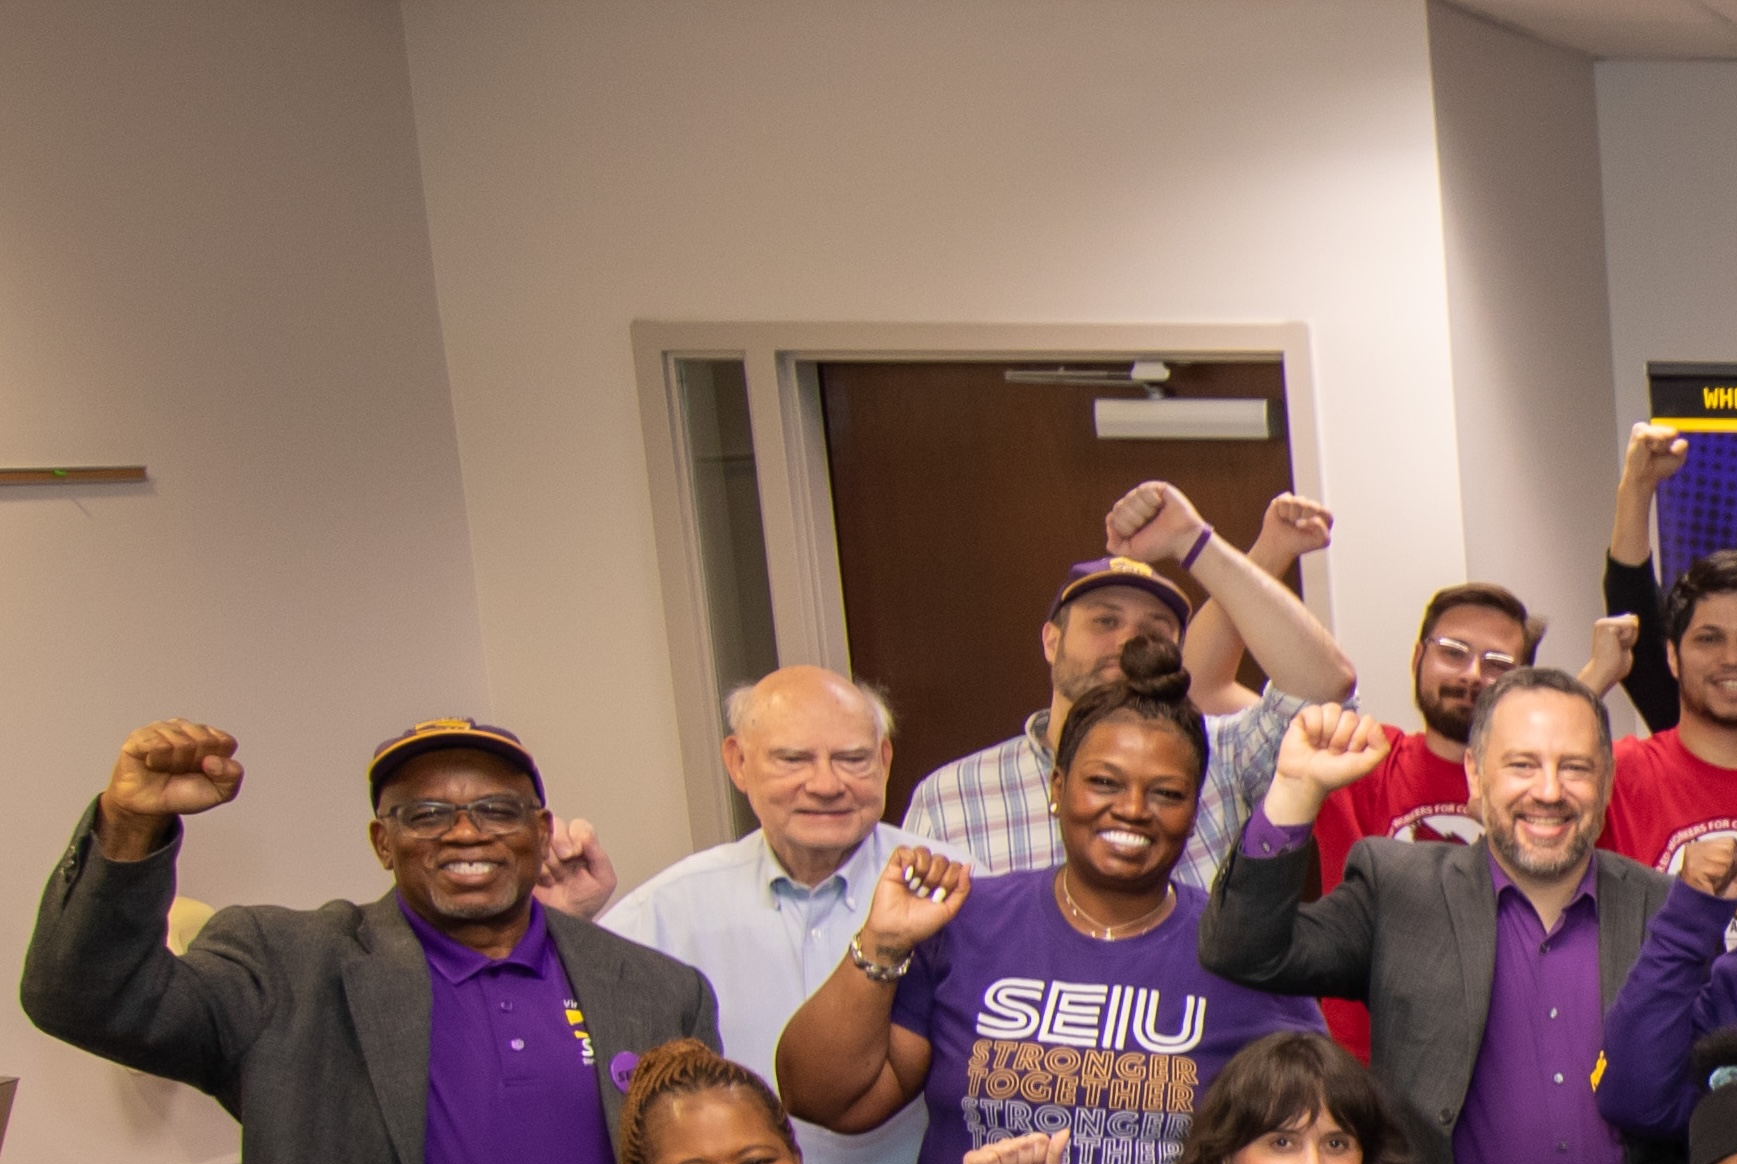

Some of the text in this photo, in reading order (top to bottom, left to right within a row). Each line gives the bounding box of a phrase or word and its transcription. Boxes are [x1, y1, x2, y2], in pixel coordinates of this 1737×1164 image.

[1708, 819, 1730, 830] FOR
[975, 977, 1207, 1055] SEIU
[967, 1038, 1200, 1086] STRONGER
[966, 1066, 1195, 1113] TOGETHER
[961, 1097, 1194, 1141] STRONGER
